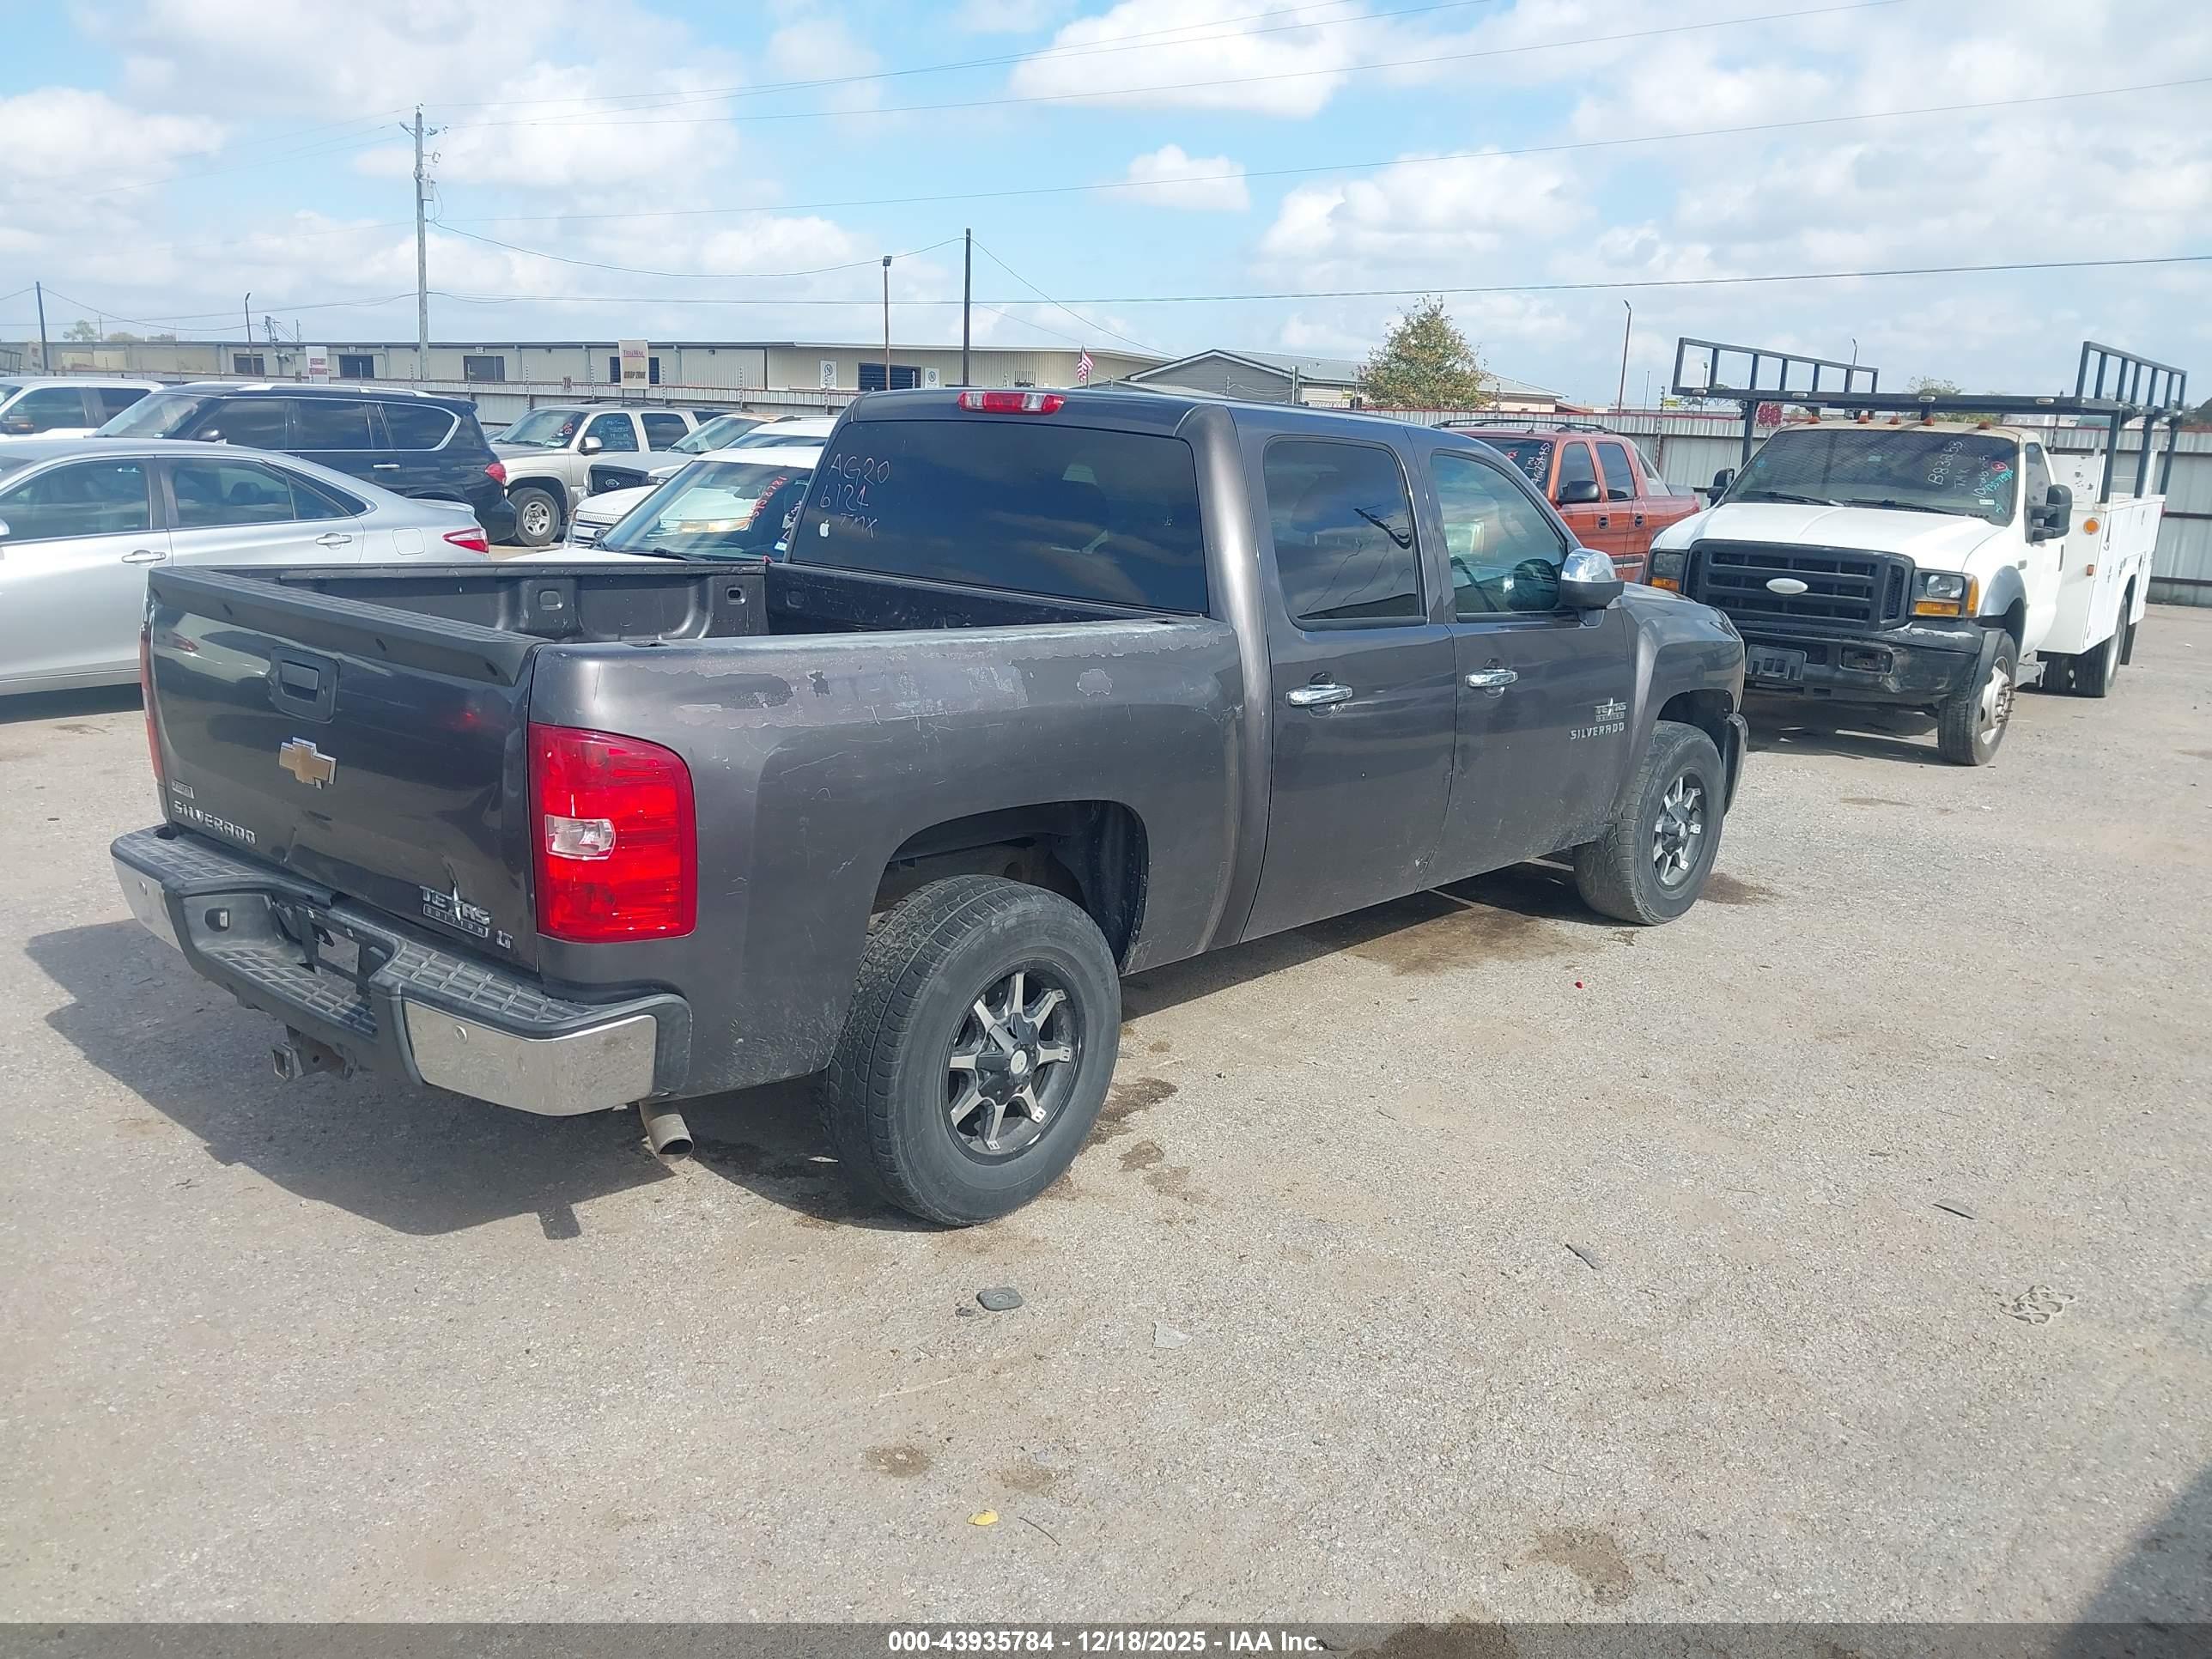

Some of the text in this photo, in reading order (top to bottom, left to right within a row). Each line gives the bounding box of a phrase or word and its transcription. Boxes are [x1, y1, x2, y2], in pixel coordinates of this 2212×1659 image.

[827, 453, 890, 487] AG20
[819, 483, 870, 513] 6124
[1570, 722, 1626, 739] SILVERADO
[173, 799, 257, 845] SILVERADO
[419, 884, 490, 925] TEXAS
[495, 930, 514, 949] LT
